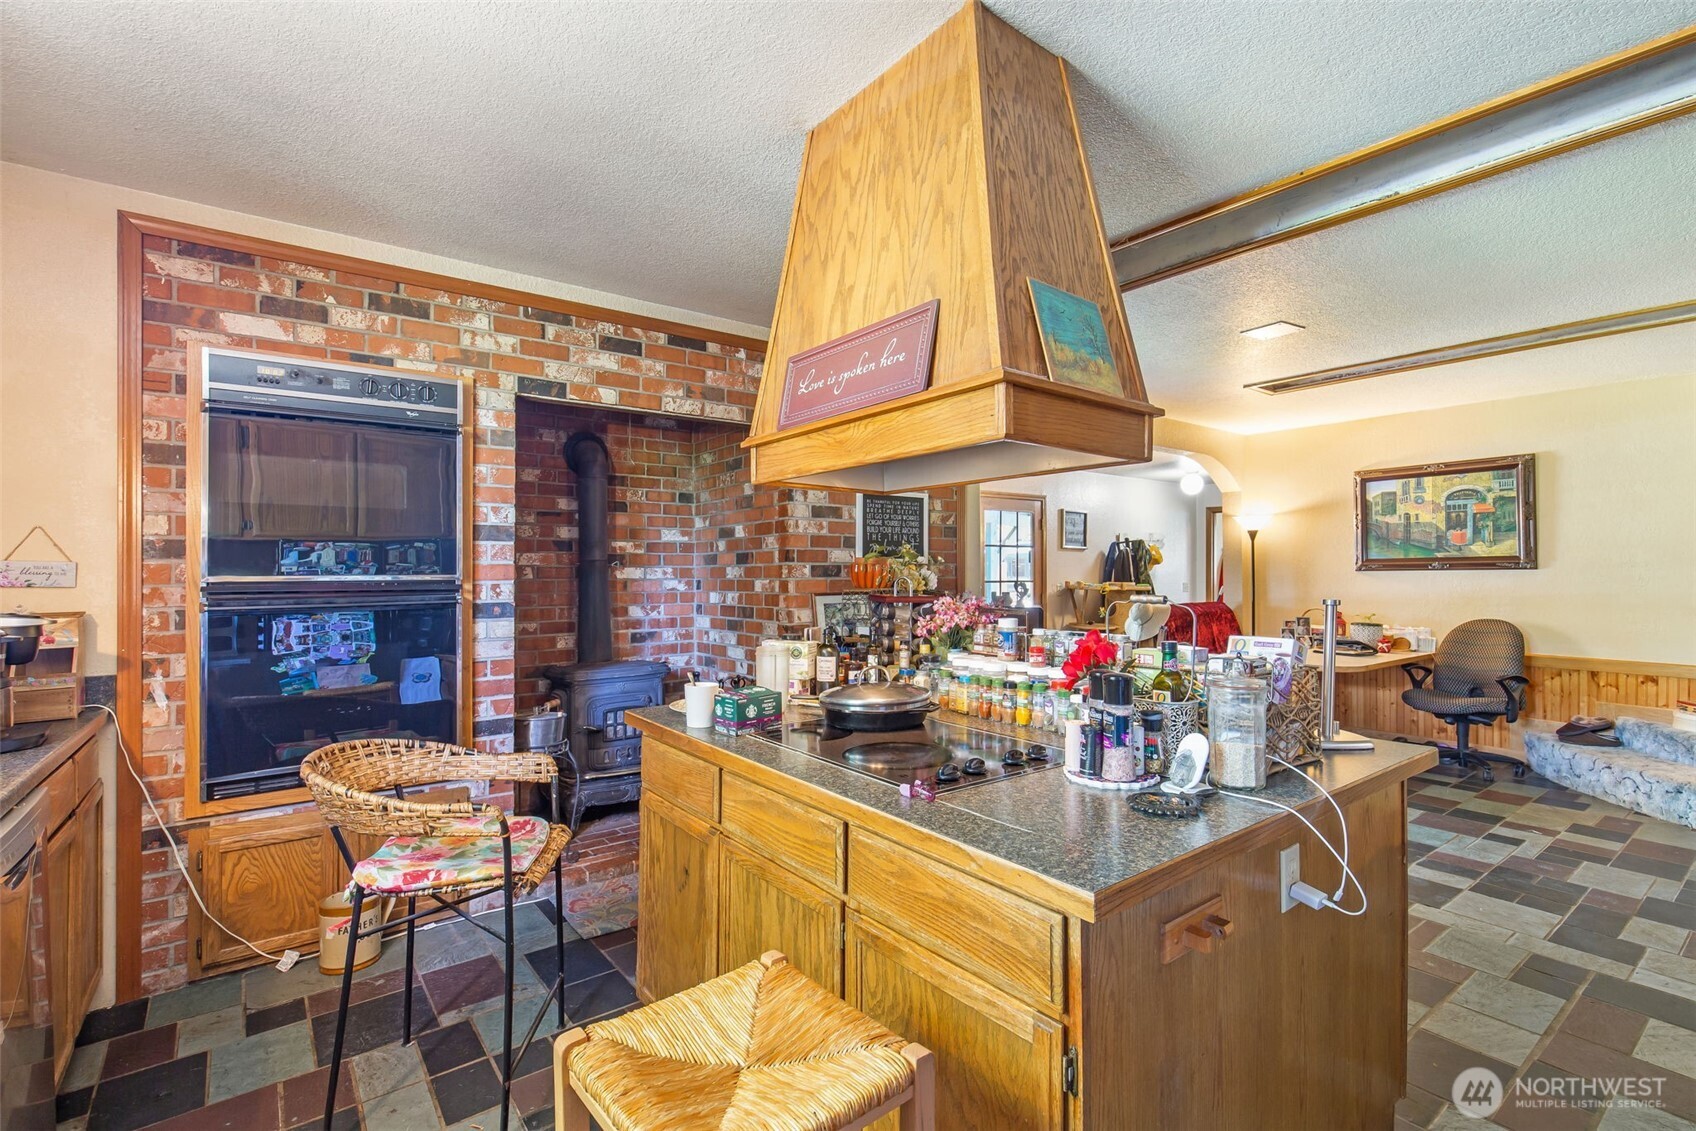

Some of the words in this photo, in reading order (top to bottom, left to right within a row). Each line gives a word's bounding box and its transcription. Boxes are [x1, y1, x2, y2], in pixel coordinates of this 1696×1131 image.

[798, 368, 825, 395] Love
[827, 370, 836, 384] is
[834, 351, 876, 395] spoken
[880, 337, 907, 367] here
[867, 533, 882, 541] THE
[888, 533, 920, 542] THINGS
[338, 914, 378, 935] FAHER'S
